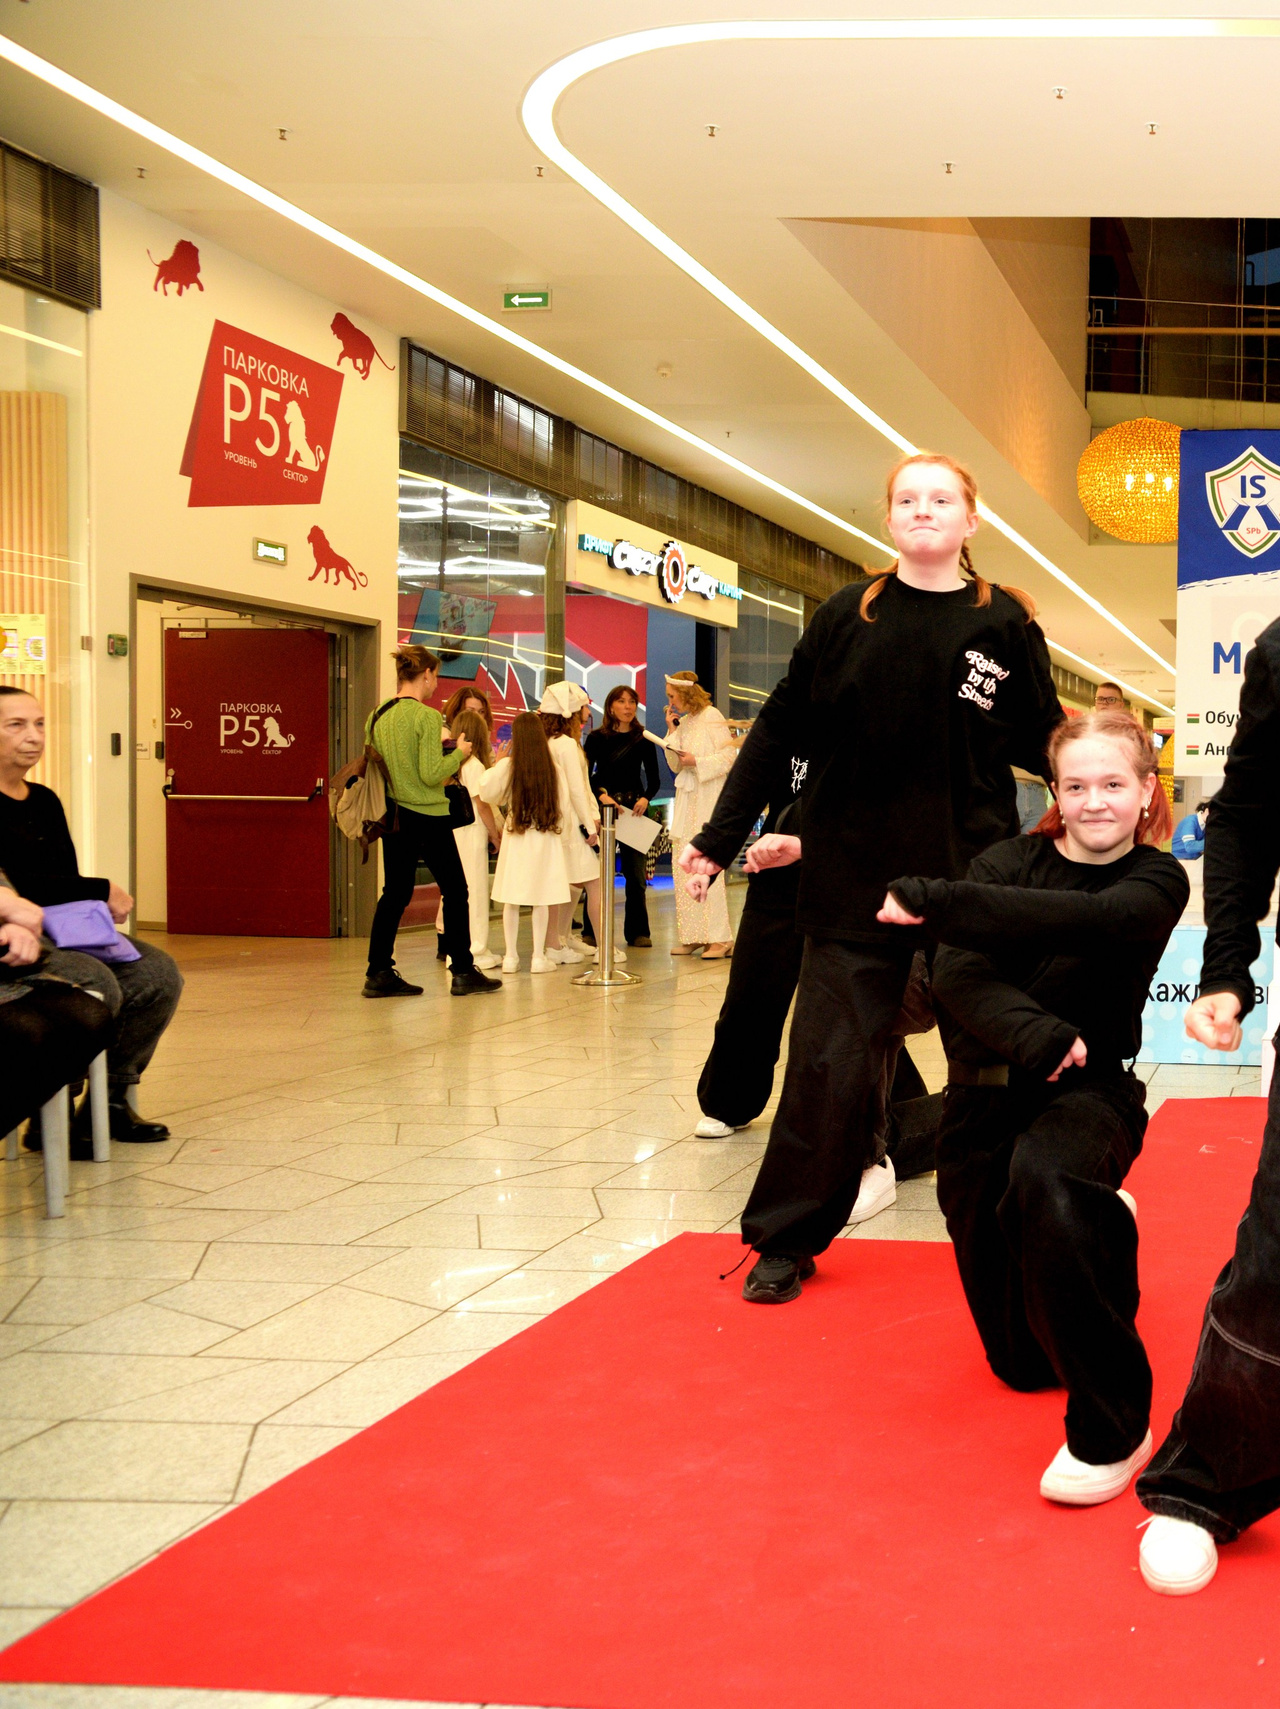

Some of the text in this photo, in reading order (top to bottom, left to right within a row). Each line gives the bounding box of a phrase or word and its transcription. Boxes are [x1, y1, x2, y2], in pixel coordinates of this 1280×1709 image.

[223, 345, 310, 398] ПАРКОВКА
[224, 449, 309, 484] УРОВЕНЬ СЕКТОР
[1240, 475, 1266, 499] IS
[964, 650, 1010, 681] Raised
[967, 667, 997, 695] by th
[219, 702, 282, 714] ПАРКОВКА
[958, 683, 994, 711] Streets
